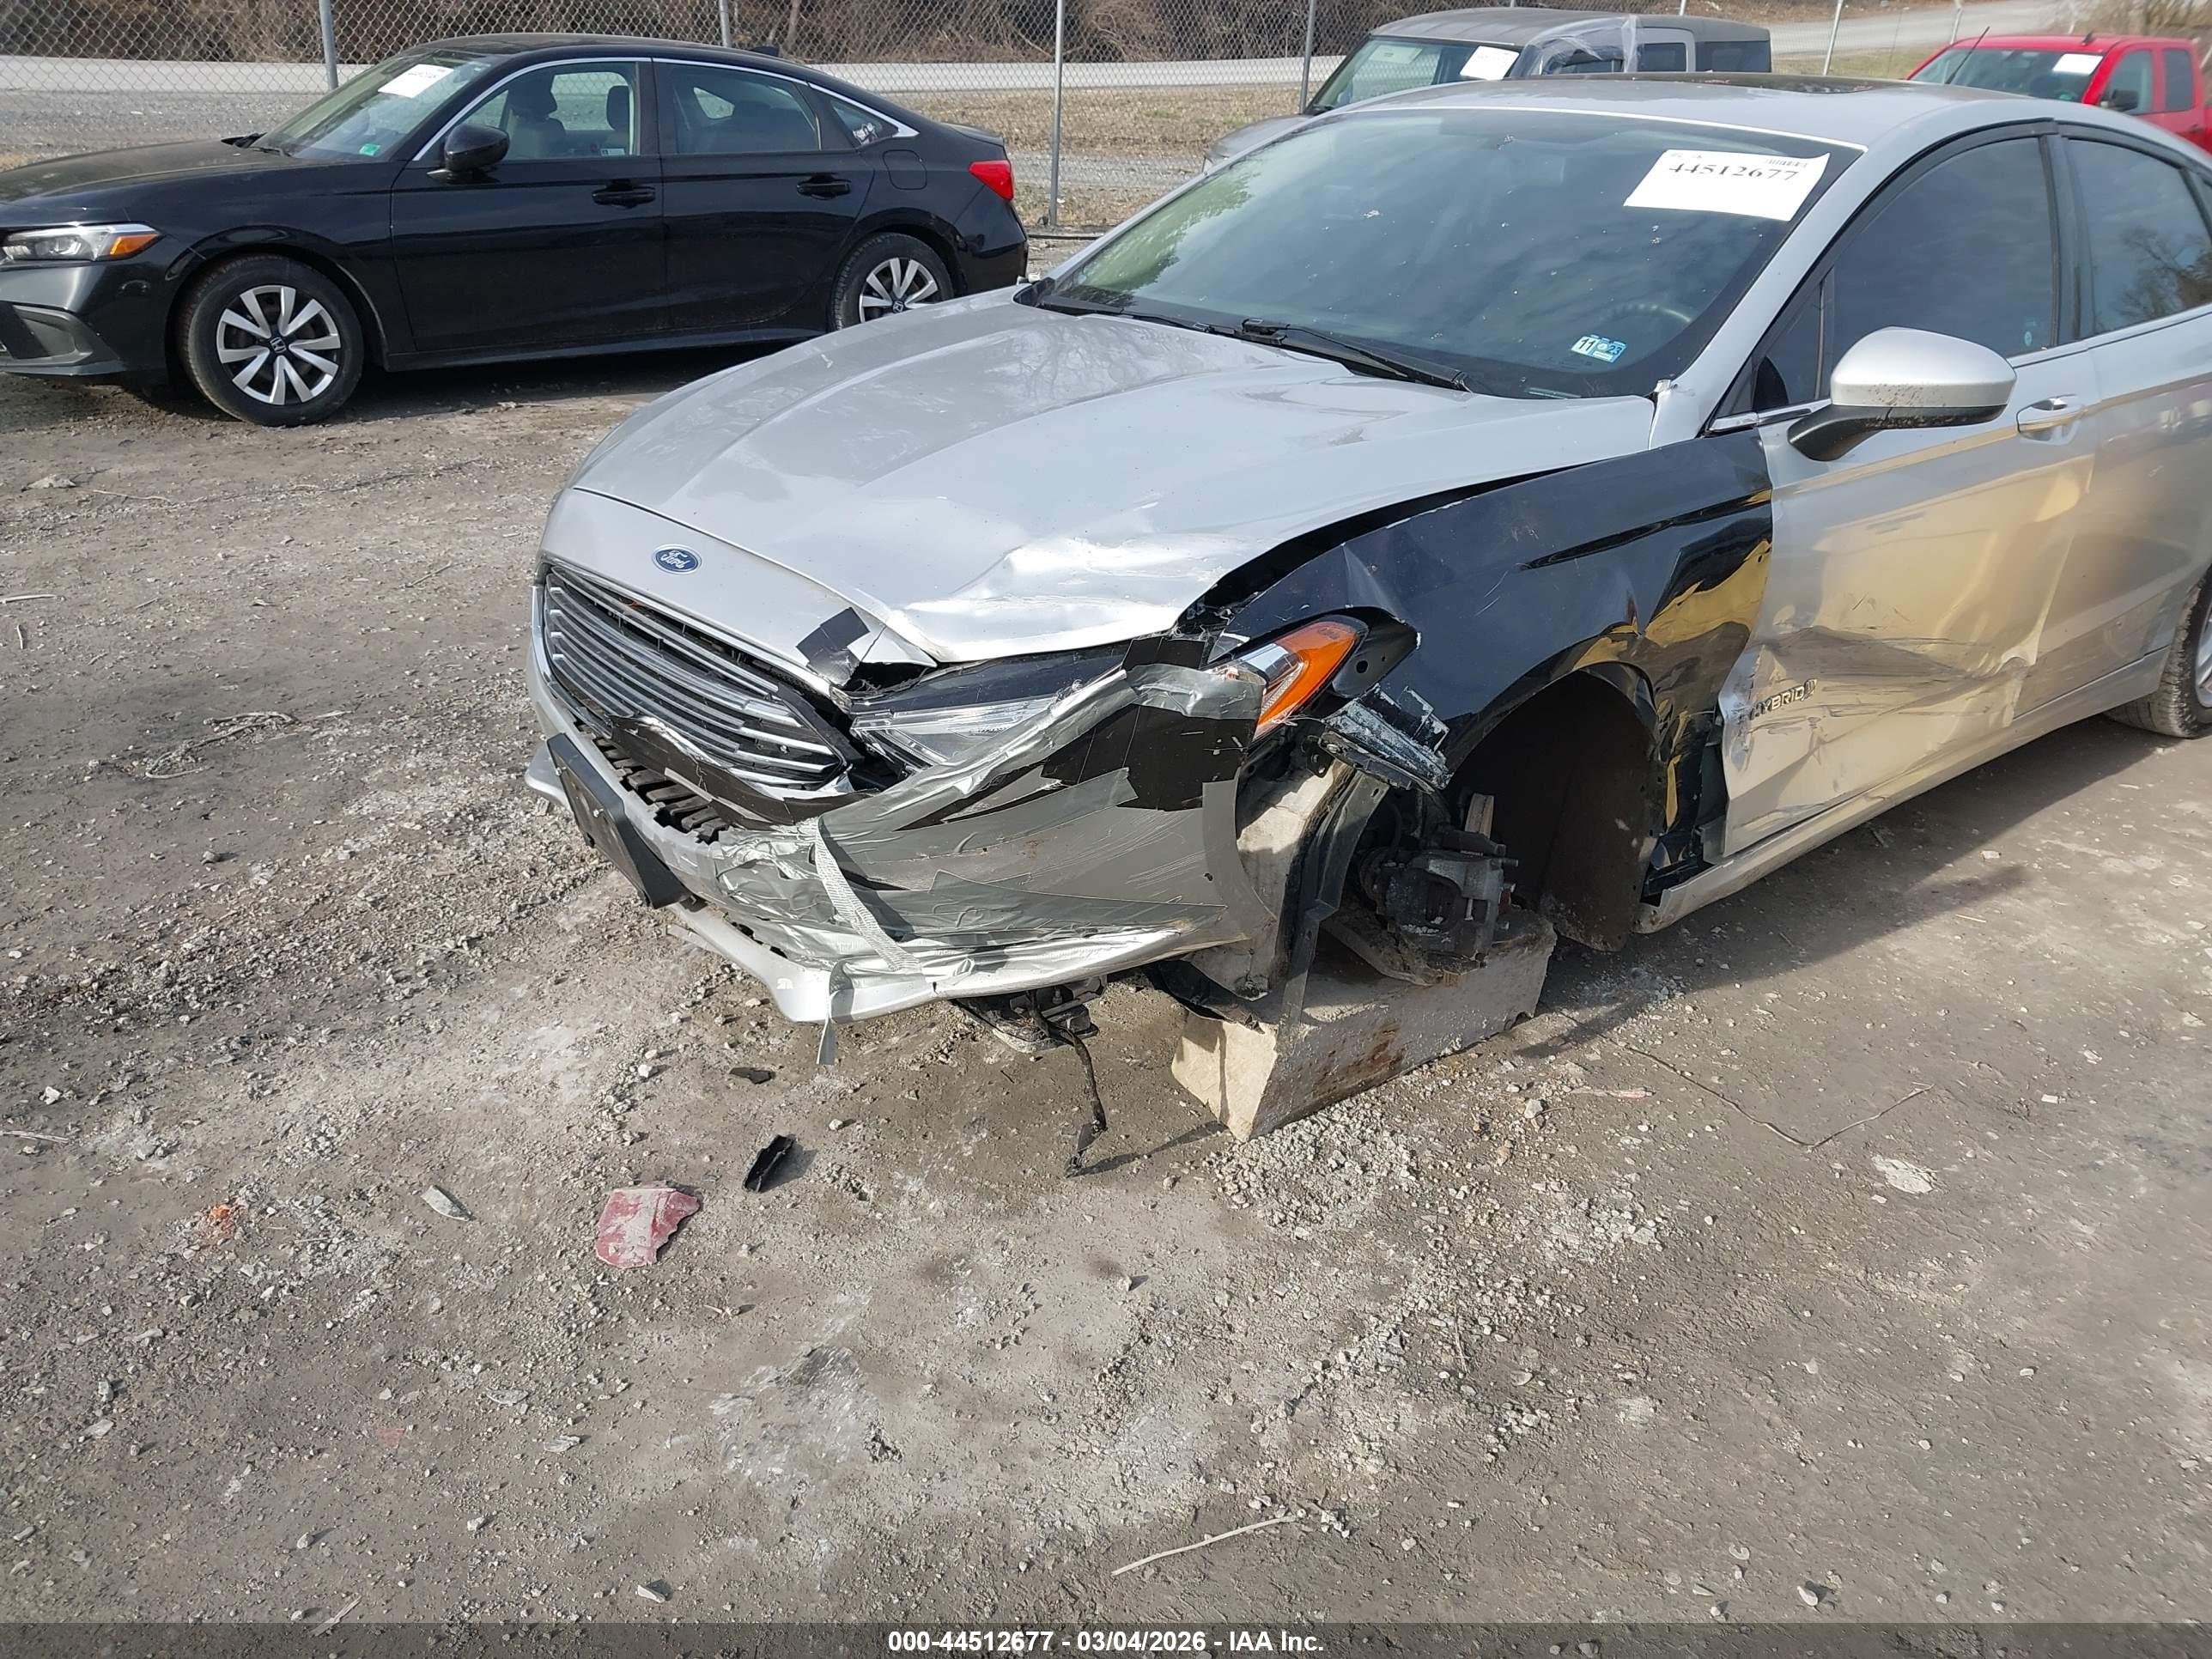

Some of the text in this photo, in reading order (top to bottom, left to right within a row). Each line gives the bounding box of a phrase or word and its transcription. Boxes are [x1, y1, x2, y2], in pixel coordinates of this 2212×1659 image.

[1669, 163, 1799, 181] 44512677
[1578, 338, 1597, 351] 11
[659, 550, 691, 568] Ford
[1748, 684, 1805, 720] HYBRID
